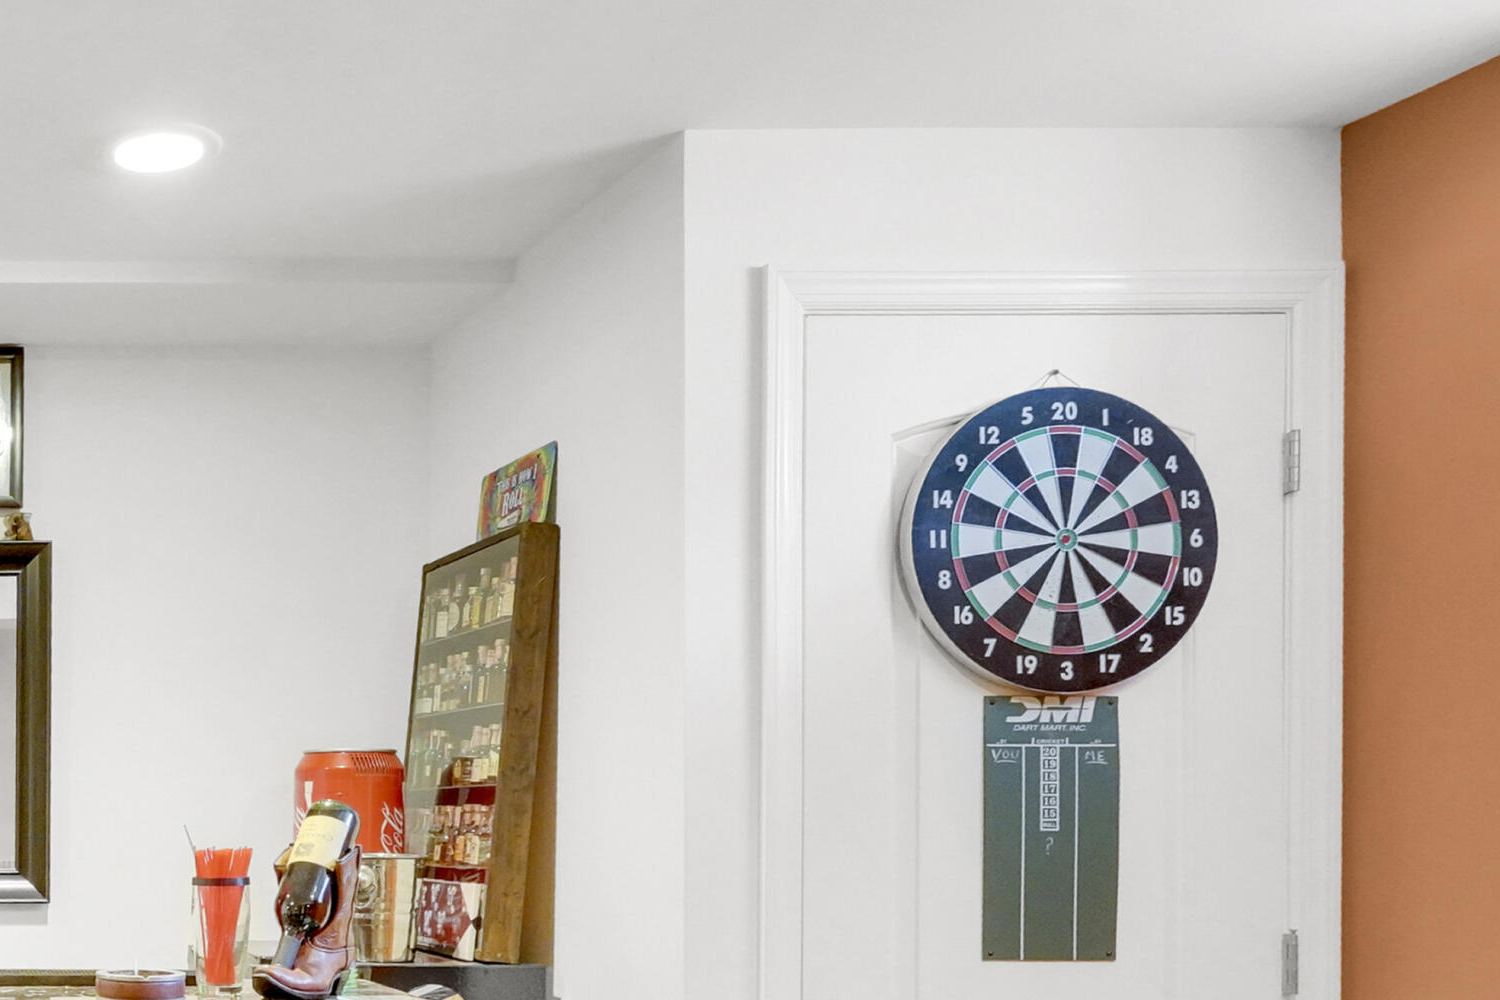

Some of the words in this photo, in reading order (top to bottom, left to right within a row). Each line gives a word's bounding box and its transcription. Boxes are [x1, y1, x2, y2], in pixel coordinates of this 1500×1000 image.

[1021, 406, 1033, 425] 5
[1051, 402, 1077, 420] 20
[1102, 409, 1108, 426] 1
[979, 426, 999, 444] 12
[1134, 427, 1153, 446] 18
[956, 454, 967, 471] 9
[1165, 455, 1178, 473] 4
[502, 487, 525, 517] ROLL
[933, 490, 953, 508] 14
[1181, 490, 1200, 509] 13
[930, 530, 947, 548] 11
[1190, 529, 1203, 548] 6
[938, 570, 951, 589] 8
[1183, 567, 1202, 586] 10
[954, 605, 973, 624] 16
[1166, 606, 1184, 625] 15
[984, 638, 996, 657] 7
[1140, 634, 1153, 652] 2
[1017, 655, 1037, 674] 19
[1060, 661, 1074, 680] 3
[1100, 654, 1120, 673] 17
[1012, 724, 1039, 732] DART
[1043, 747, 1056, 757] 20
[1043, 760, 1056, 769] 19
[1043, 772, 1056, 781] 18
[1043, 784, 1056, 793] 17
[1043, 797, 1056, 806] 16
[1043, 809, 1056, 818] 15
